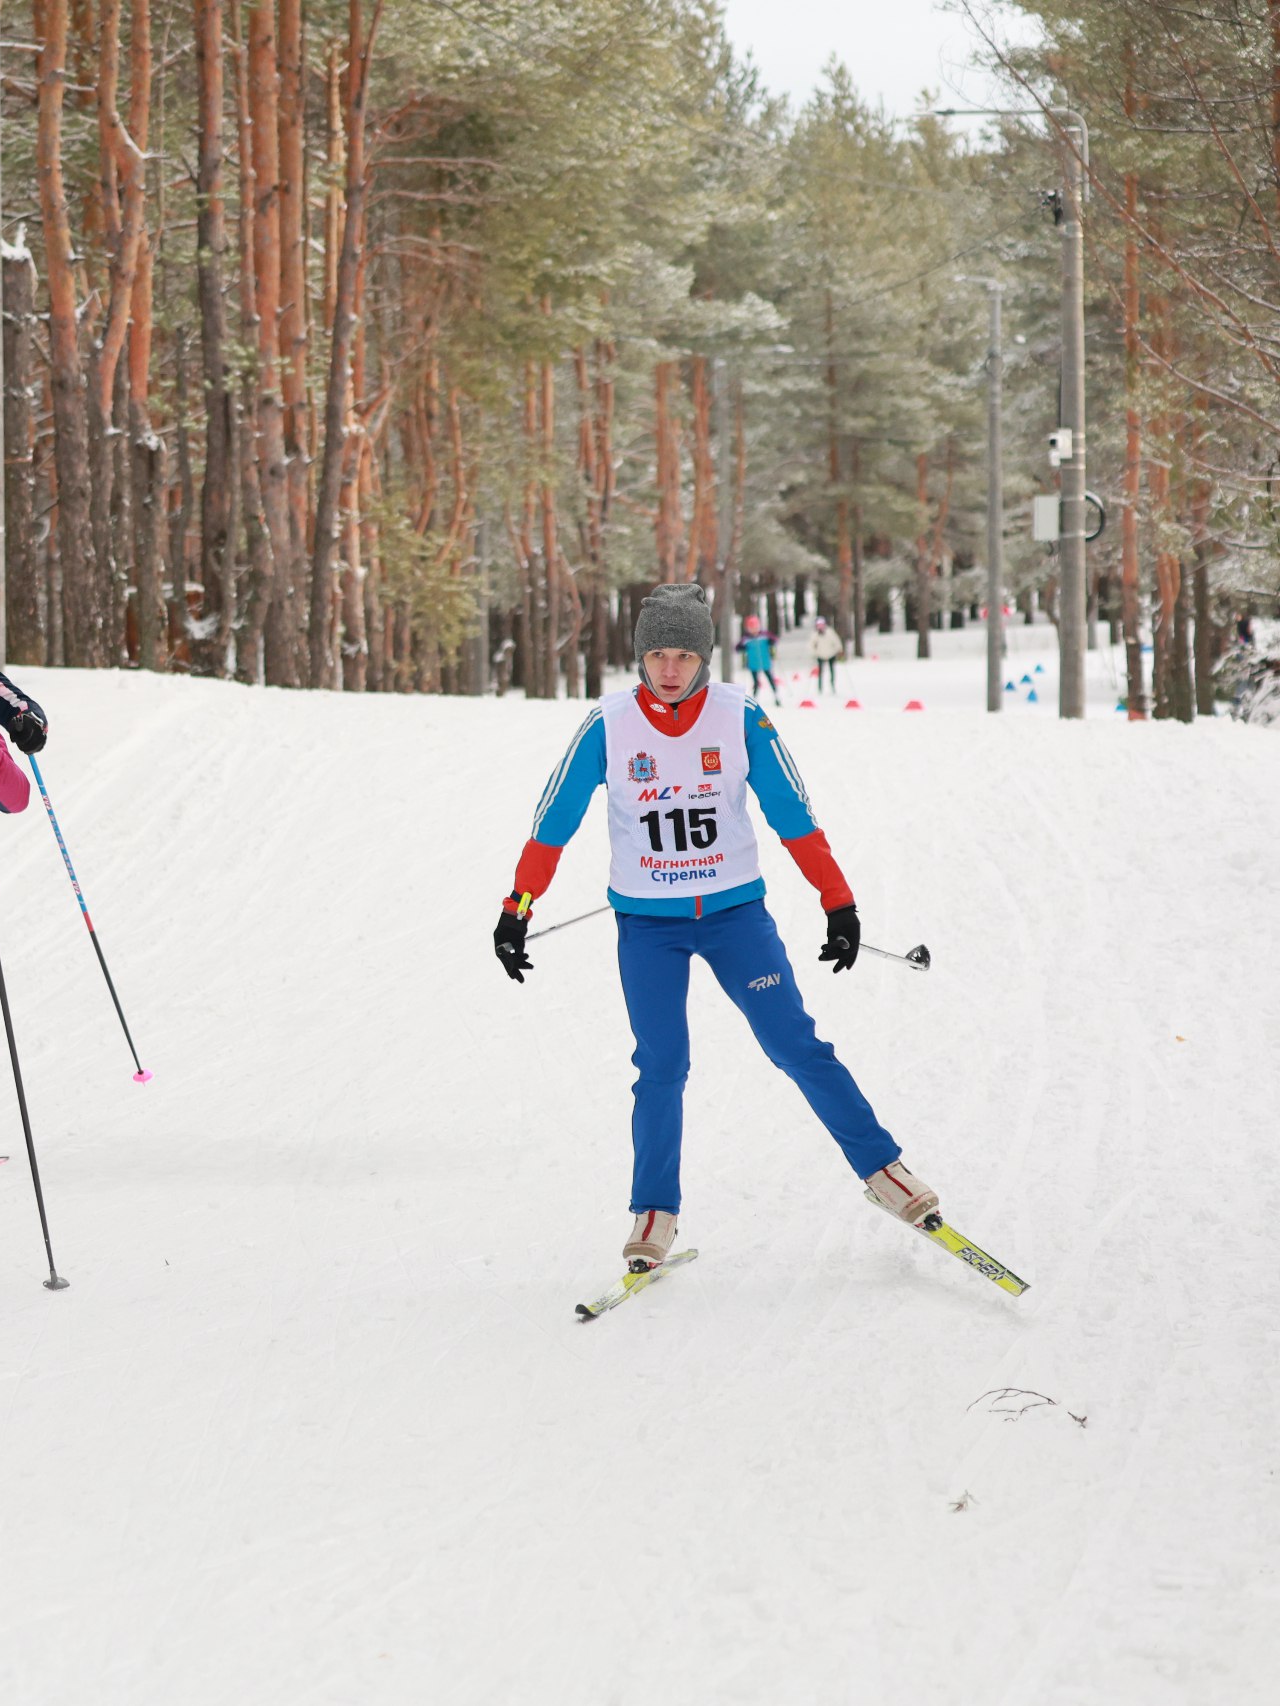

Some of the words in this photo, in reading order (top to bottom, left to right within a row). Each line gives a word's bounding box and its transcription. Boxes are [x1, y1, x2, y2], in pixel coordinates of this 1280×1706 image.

[688, 790, 722, 800] leader
[639, 807, 719, 853] 115
[640, 852, 724, 869] Магнитная
[651, 867, 717, 885] Стрелка
[956, 1247, 999, 1282] FISCHER
